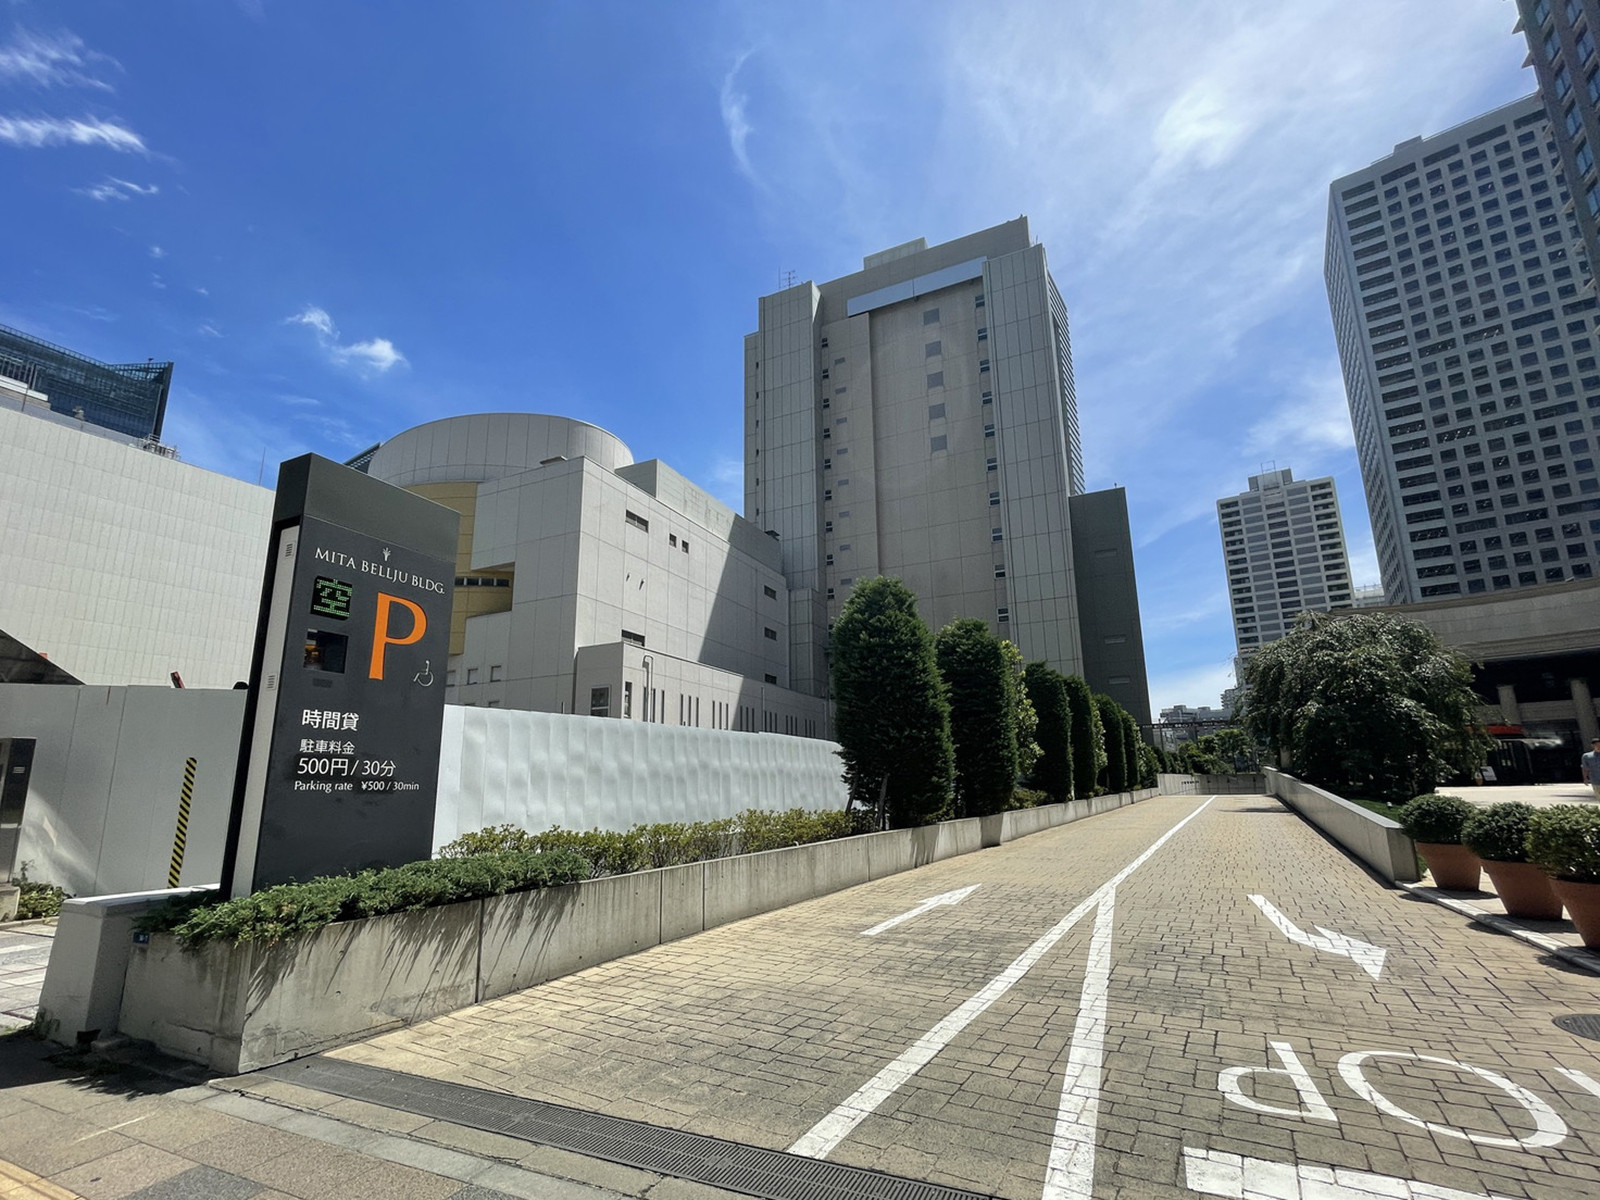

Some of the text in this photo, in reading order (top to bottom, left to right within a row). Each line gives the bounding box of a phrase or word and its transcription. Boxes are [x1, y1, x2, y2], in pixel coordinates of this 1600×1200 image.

[314, 547, 356, 569] MITA
[361, 560, 408, 583] BELLJU
[313, 578, 353, 617] 空
[368, 592, 428, 680] P
[301, 709, 359, 731] 時間貸
[299, 739, 356, 755] 駐車料金
[294, 780, 332, 793] Parking
[335, 782, 353, 791] rate
[361, 781, 385, 791] ¥500
[393, 781, 420, 791] 30min
